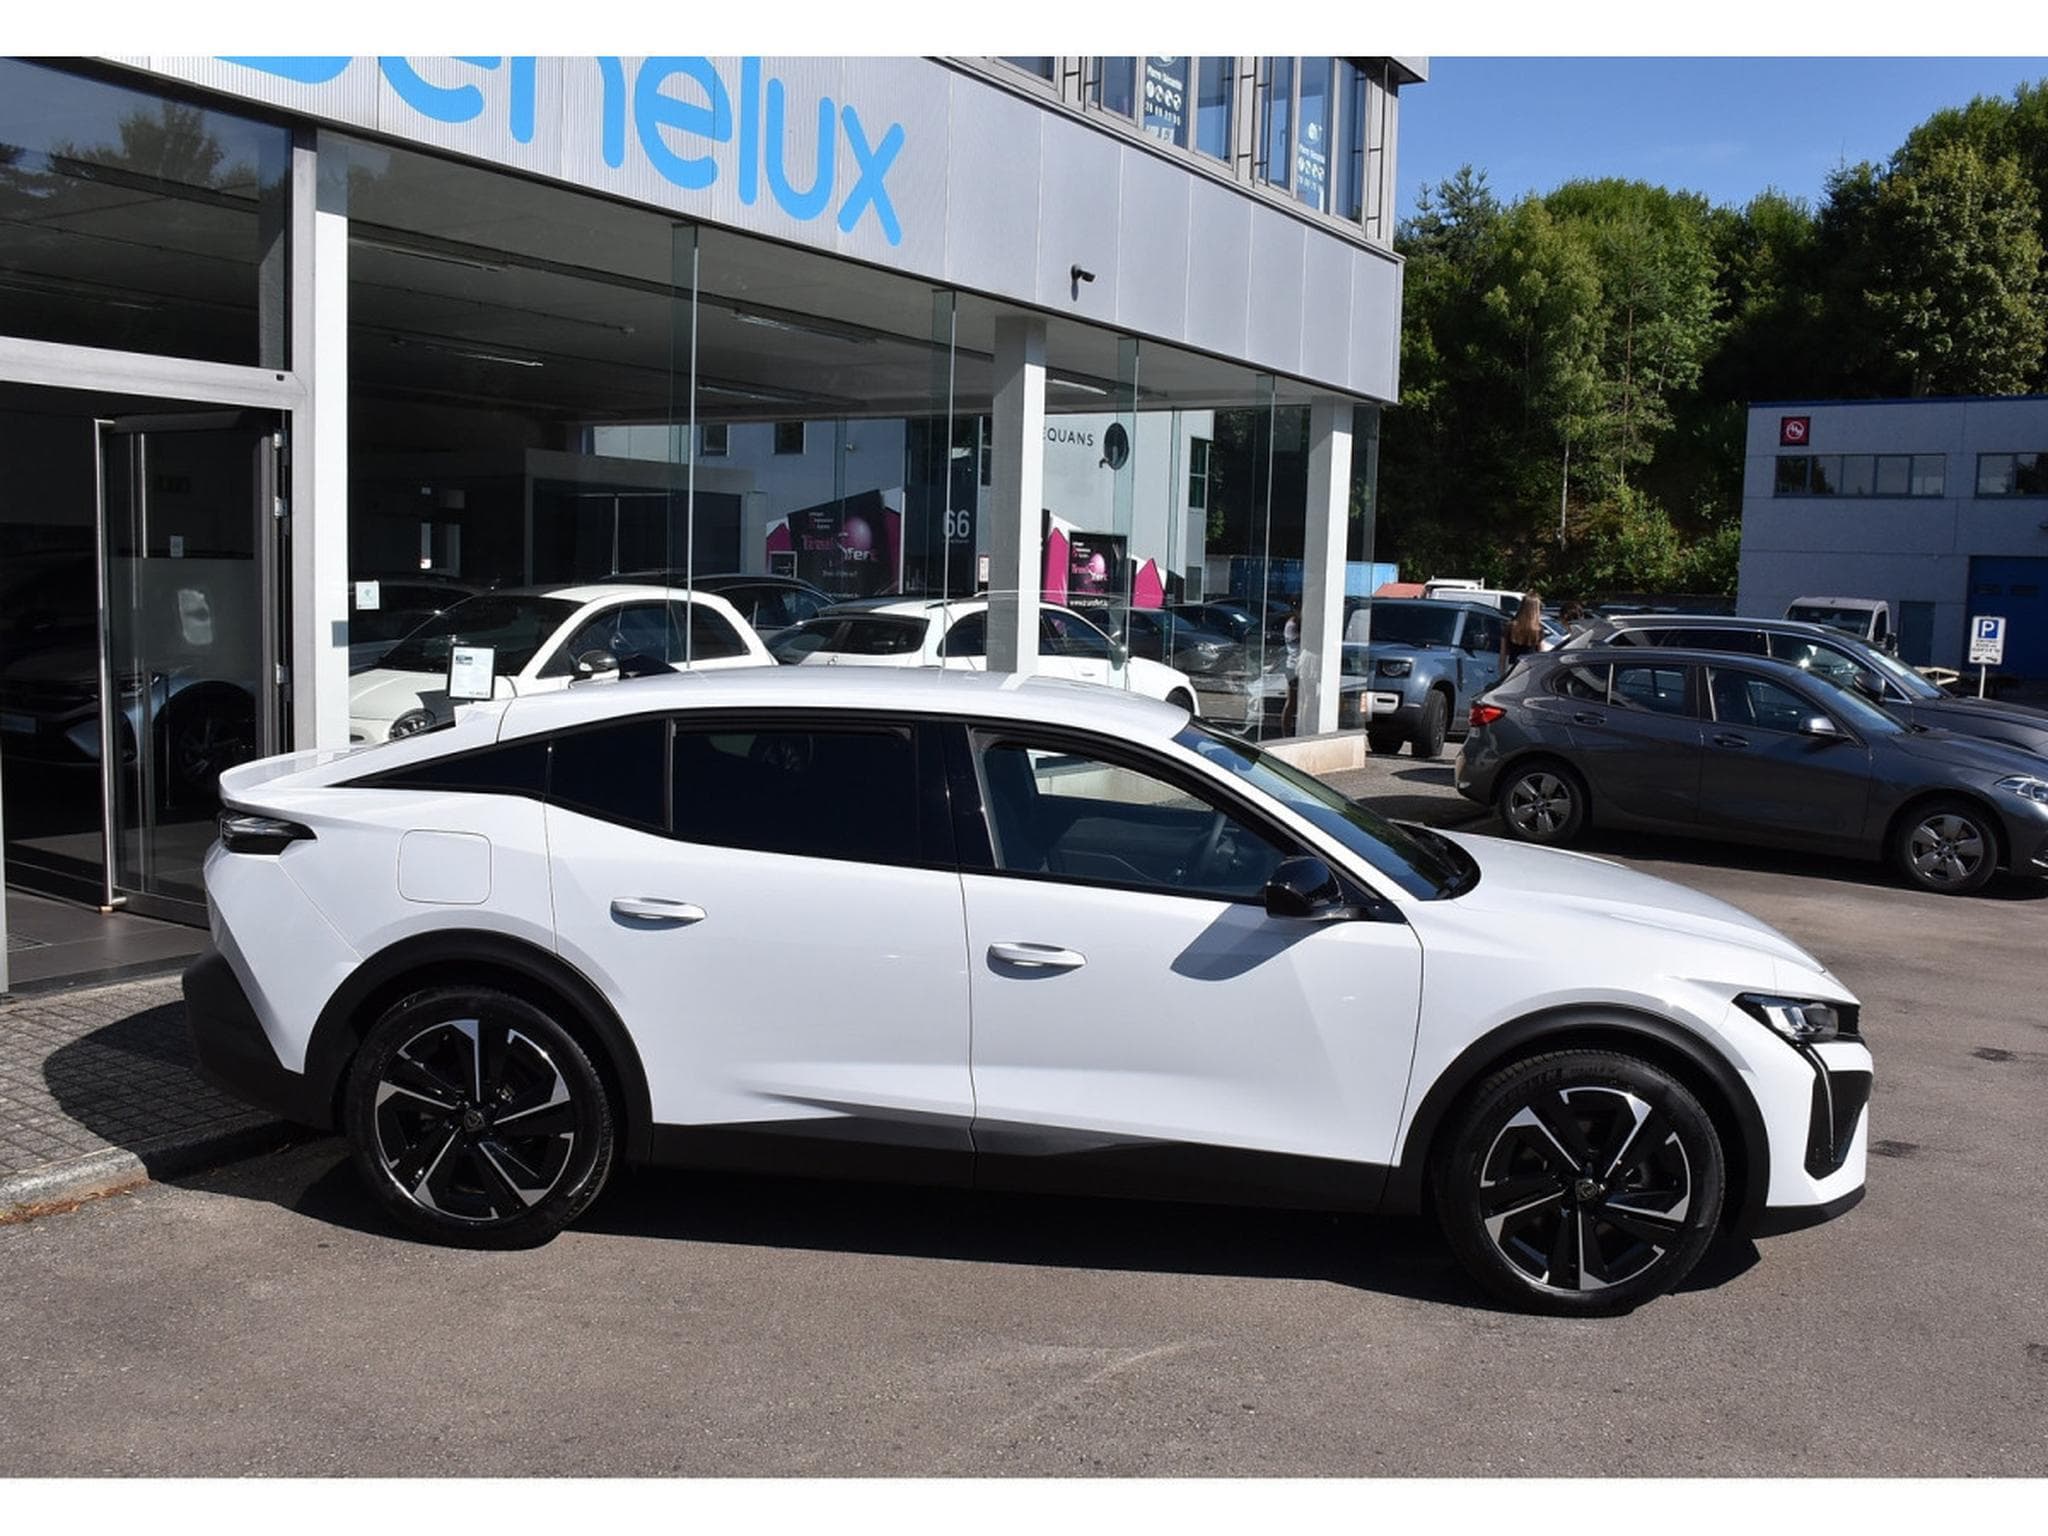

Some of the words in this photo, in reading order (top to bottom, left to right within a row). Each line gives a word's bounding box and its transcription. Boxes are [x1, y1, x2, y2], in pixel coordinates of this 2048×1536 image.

[214, 56, 905, 247] nelux
[943, 509, 970, 538] 66
[1981, 620, 1995, 638] P
